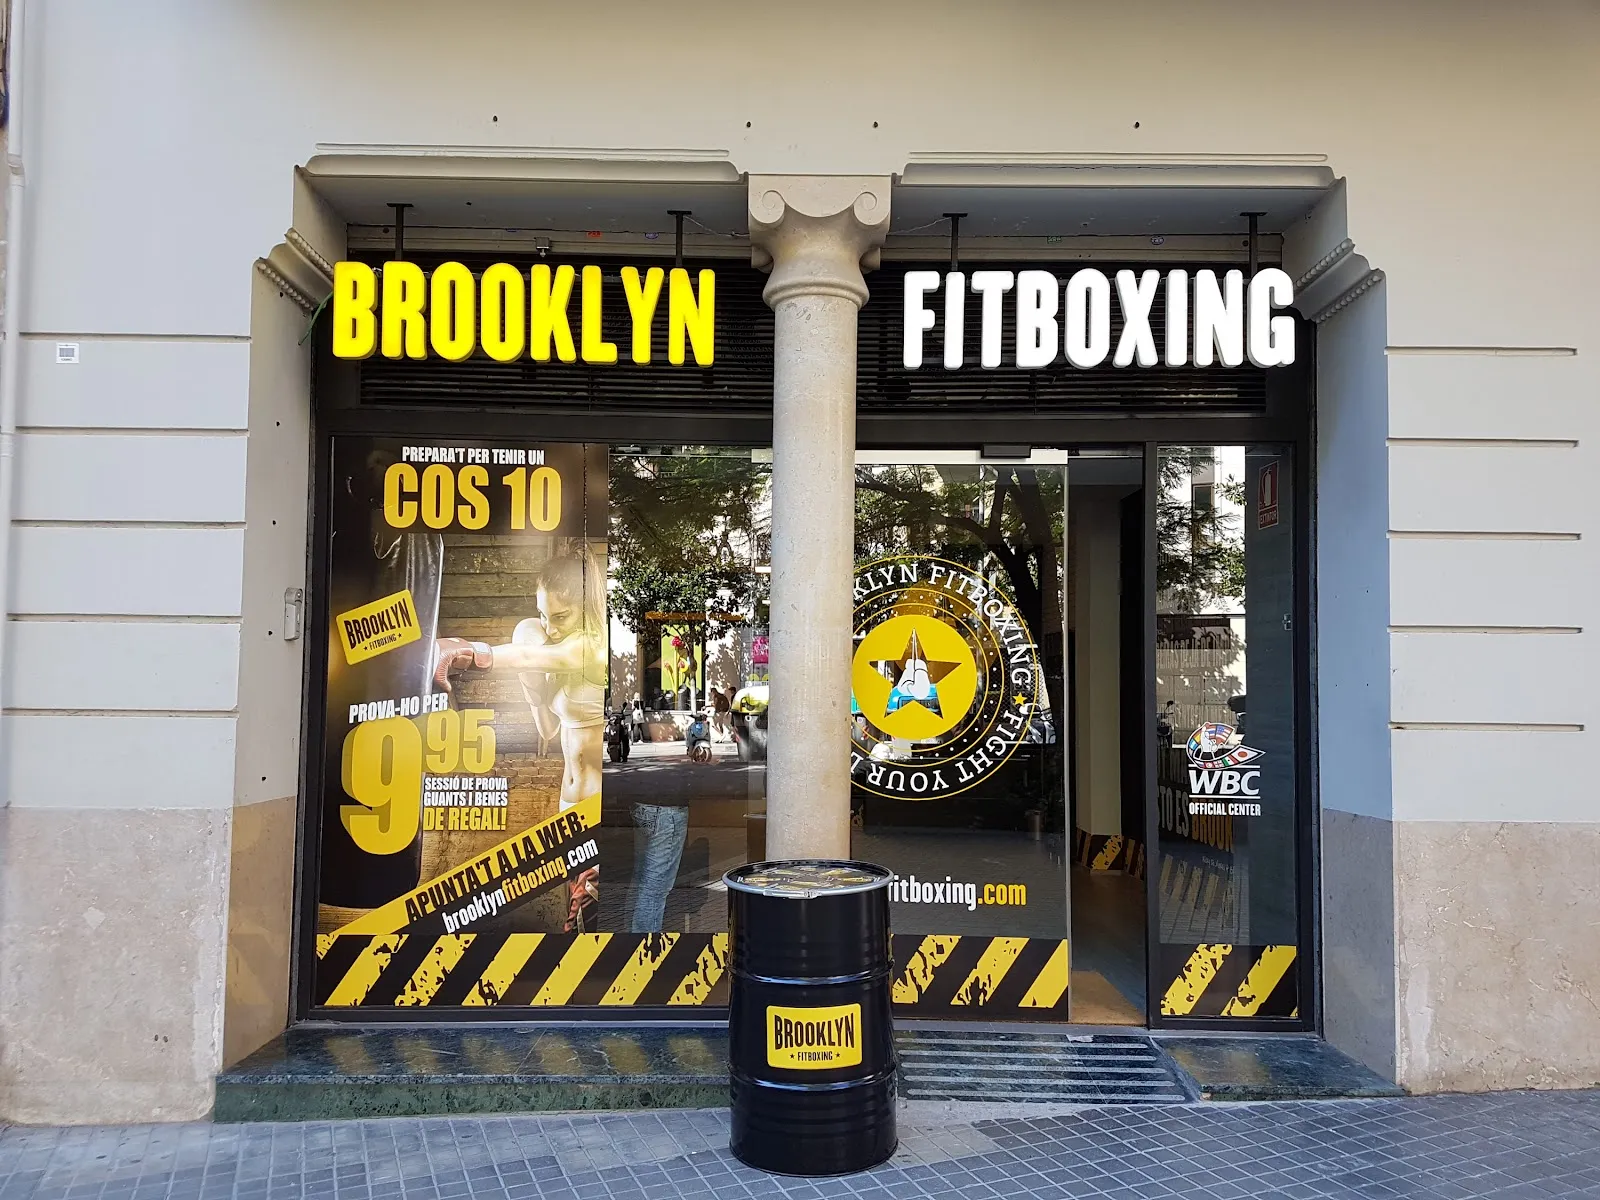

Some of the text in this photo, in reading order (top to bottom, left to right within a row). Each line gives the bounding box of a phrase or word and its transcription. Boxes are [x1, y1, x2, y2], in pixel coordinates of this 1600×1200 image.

[332, 261, 1296, 369] BROOKLYN FITBOXING
[402, 446, 545, 465] PREPARA'T PER TENIR UN
[383, 463, 562, 531] COS 10
[344, 597, 413, 650] BROOKLYN
[852, 563, 1032, 687] KLYN FITBOXING
[369, 633, 398, 651] FITBOXING
[348, 692, 448, 723] PROVA-HO PER
[868, 709, 1024, 792] FIGHT YOUR
[423, 791, 508, 806] GUANTS I BENES
[424, 775, 508, 791] SESSIÓ DE PROVA
[1188, 770, 1261, 796] WBC
[423, 807, 507, 831] DE REGAL!
[1188, 802, 1261, 816] OFFICIAL CENTER
[404, 857, 496, 923] APUNTA'T
[511, 835, 535, 863] LA
[441, 838, 599, 934] brooklynfitboxing.com
[774, 1012, 855, 1050] BROOKLYN
[797, 1051, 833, 1062] FITBOXING
